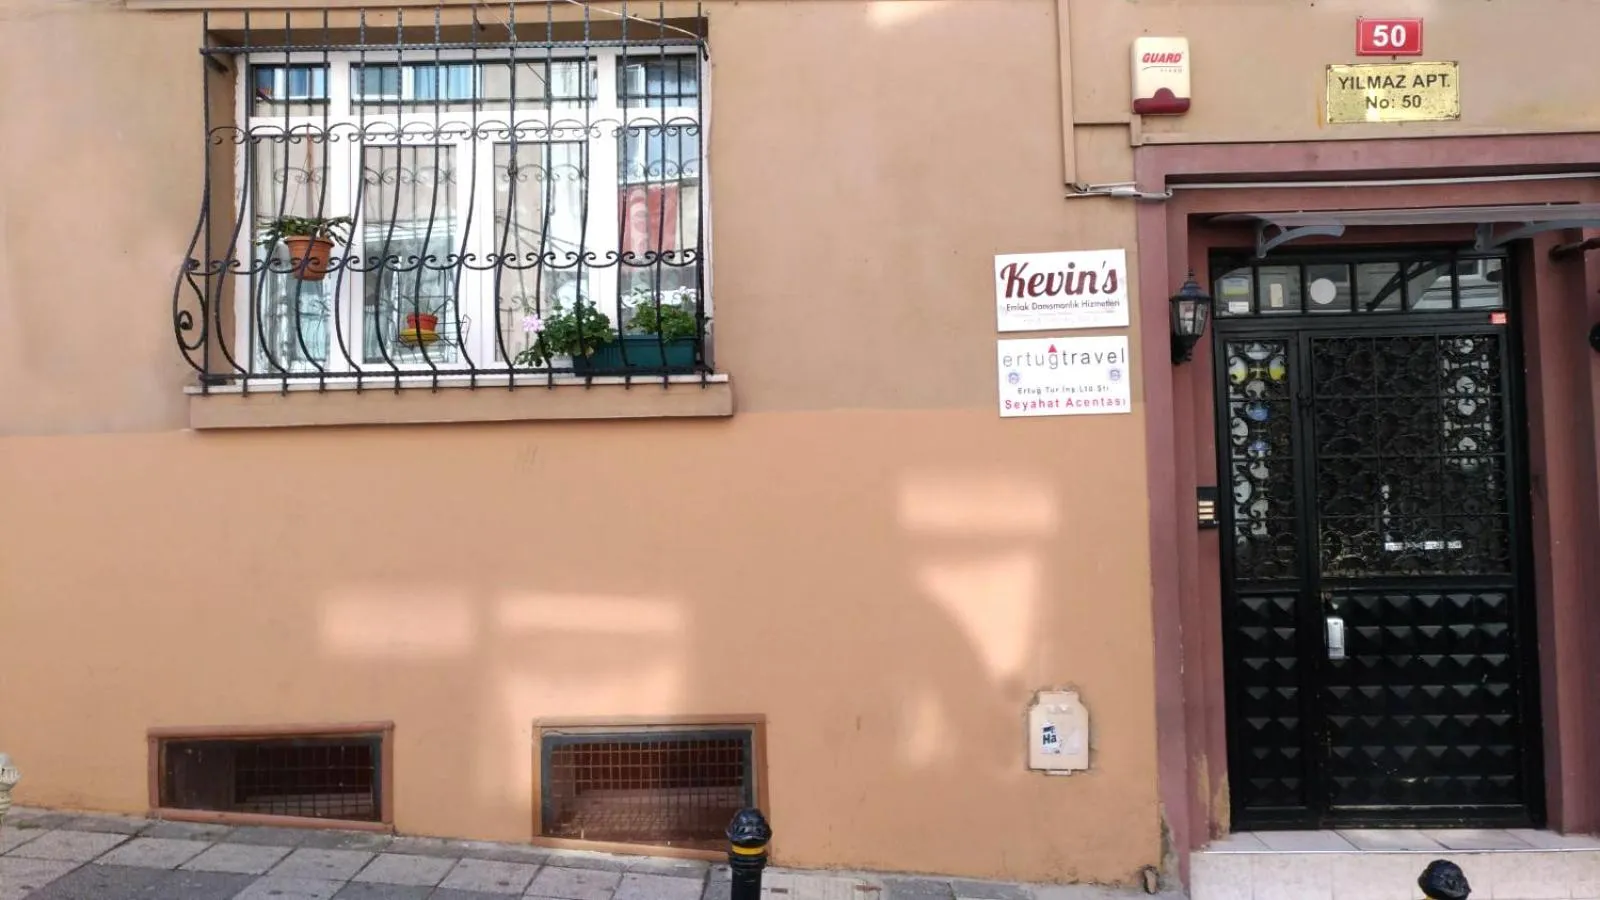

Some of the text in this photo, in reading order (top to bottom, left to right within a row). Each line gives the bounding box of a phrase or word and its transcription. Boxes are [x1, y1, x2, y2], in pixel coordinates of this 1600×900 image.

[1372, 25, 1407, 48] 50
[1142, 52, 1182, 64] GUARD
[1338, 73, 1451, 91] YILMAZ APT.
[1365, 94, 1422, 110] No: 50
[1000, 260, 1119, 299] Kevin's
[1006, 301, 1030, 312] Emlak
[1004, 397, 1127, 412] Seyahat Acentası
